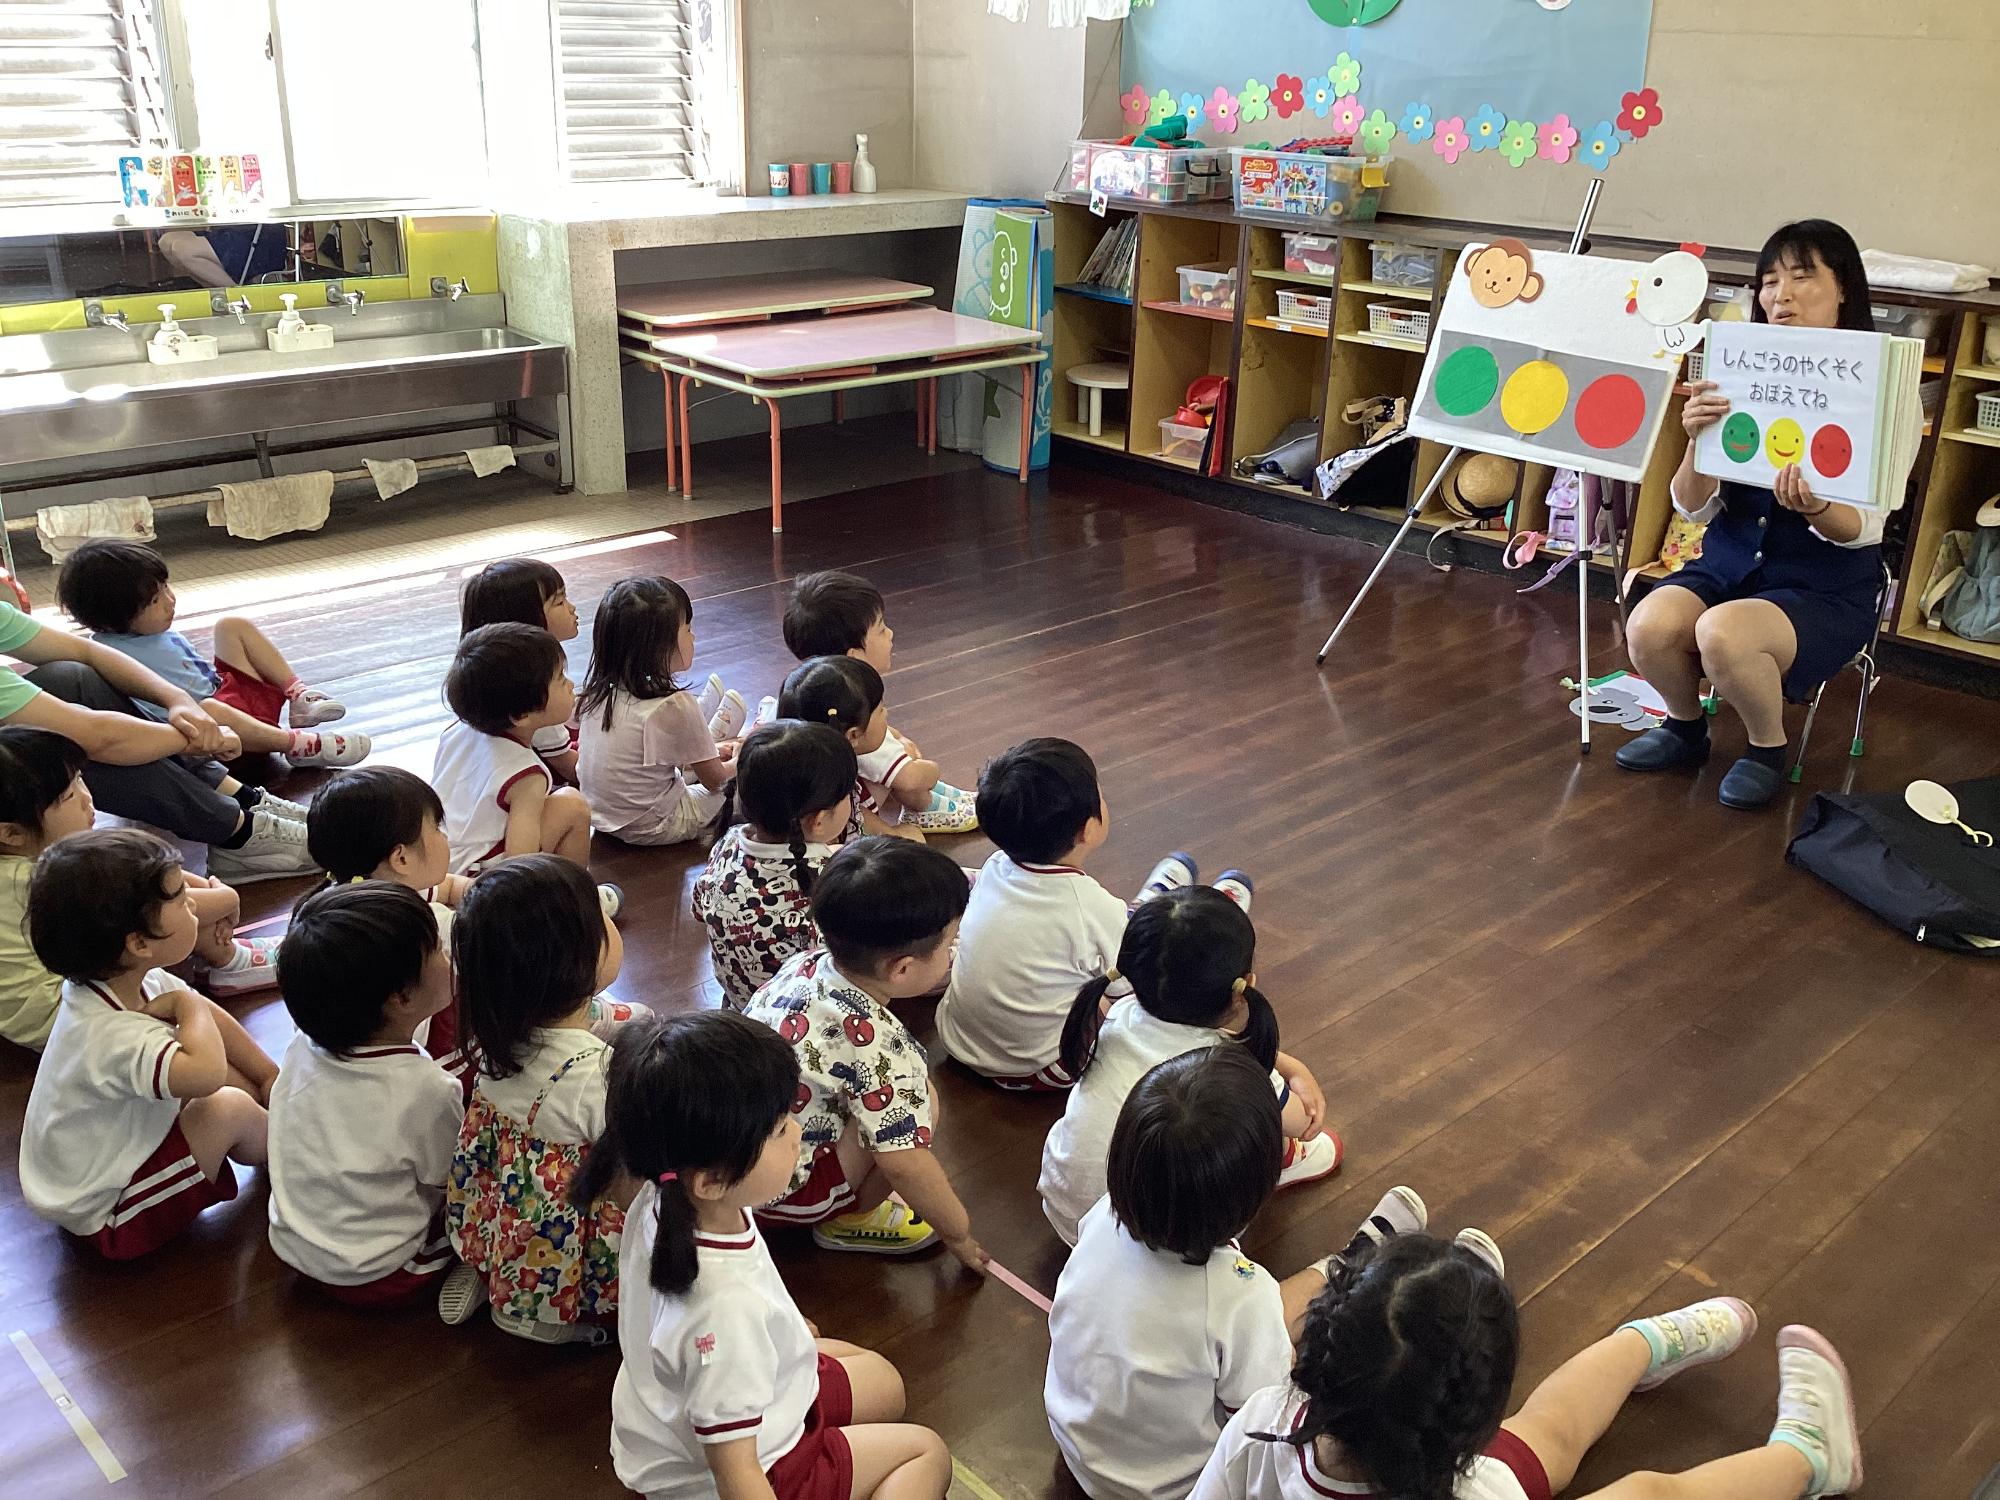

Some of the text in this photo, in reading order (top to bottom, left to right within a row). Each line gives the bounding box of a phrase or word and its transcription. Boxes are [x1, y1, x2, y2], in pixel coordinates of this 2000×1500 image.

[1722, 347, 1864, 382] しんごうのやくそく
[1749, 382, 1829, 410] おぼえてね
